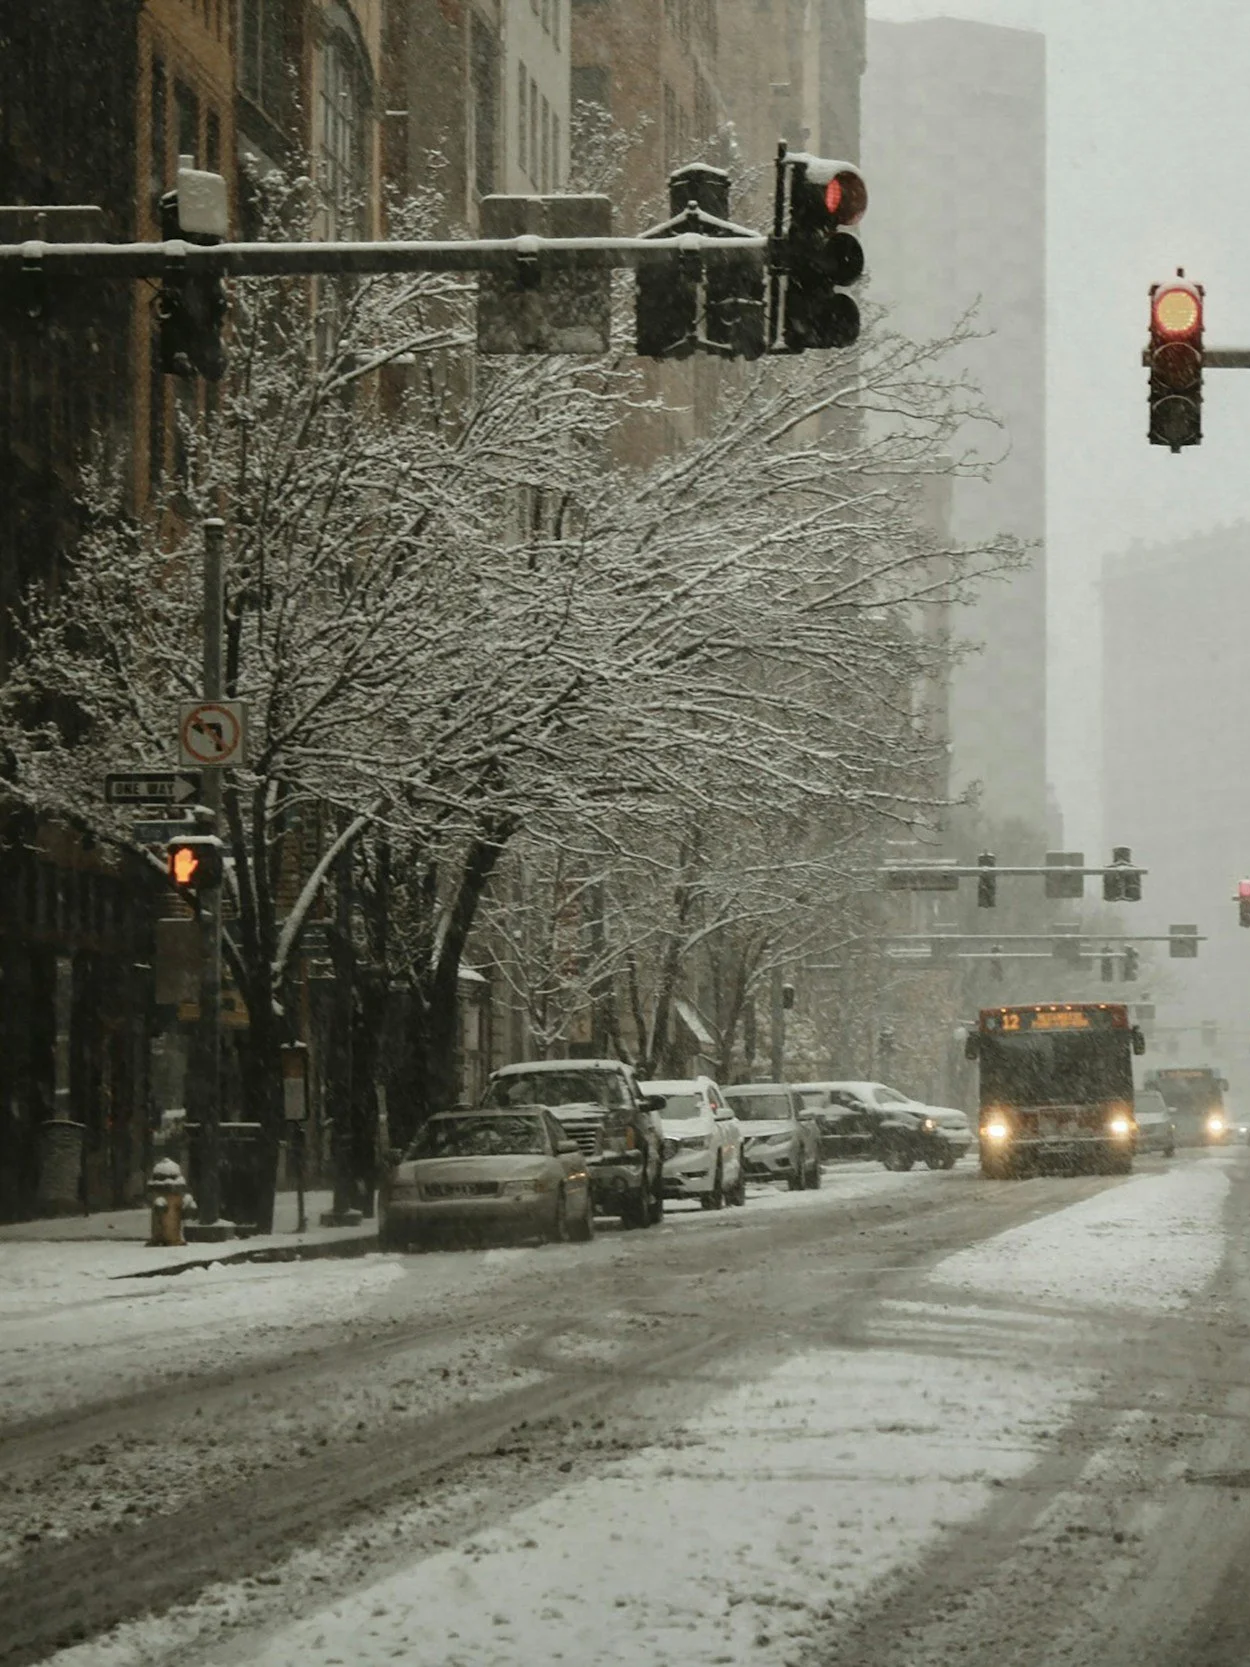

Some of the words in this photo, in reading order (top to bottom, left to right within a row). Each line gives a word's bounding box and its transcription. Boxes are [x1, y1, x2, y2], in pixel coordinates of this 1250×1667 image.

[114, 783, 140, 795] ONE
[147, 783, 173, 795] WAY
[1002, 1013, 1021, 1030] 12
